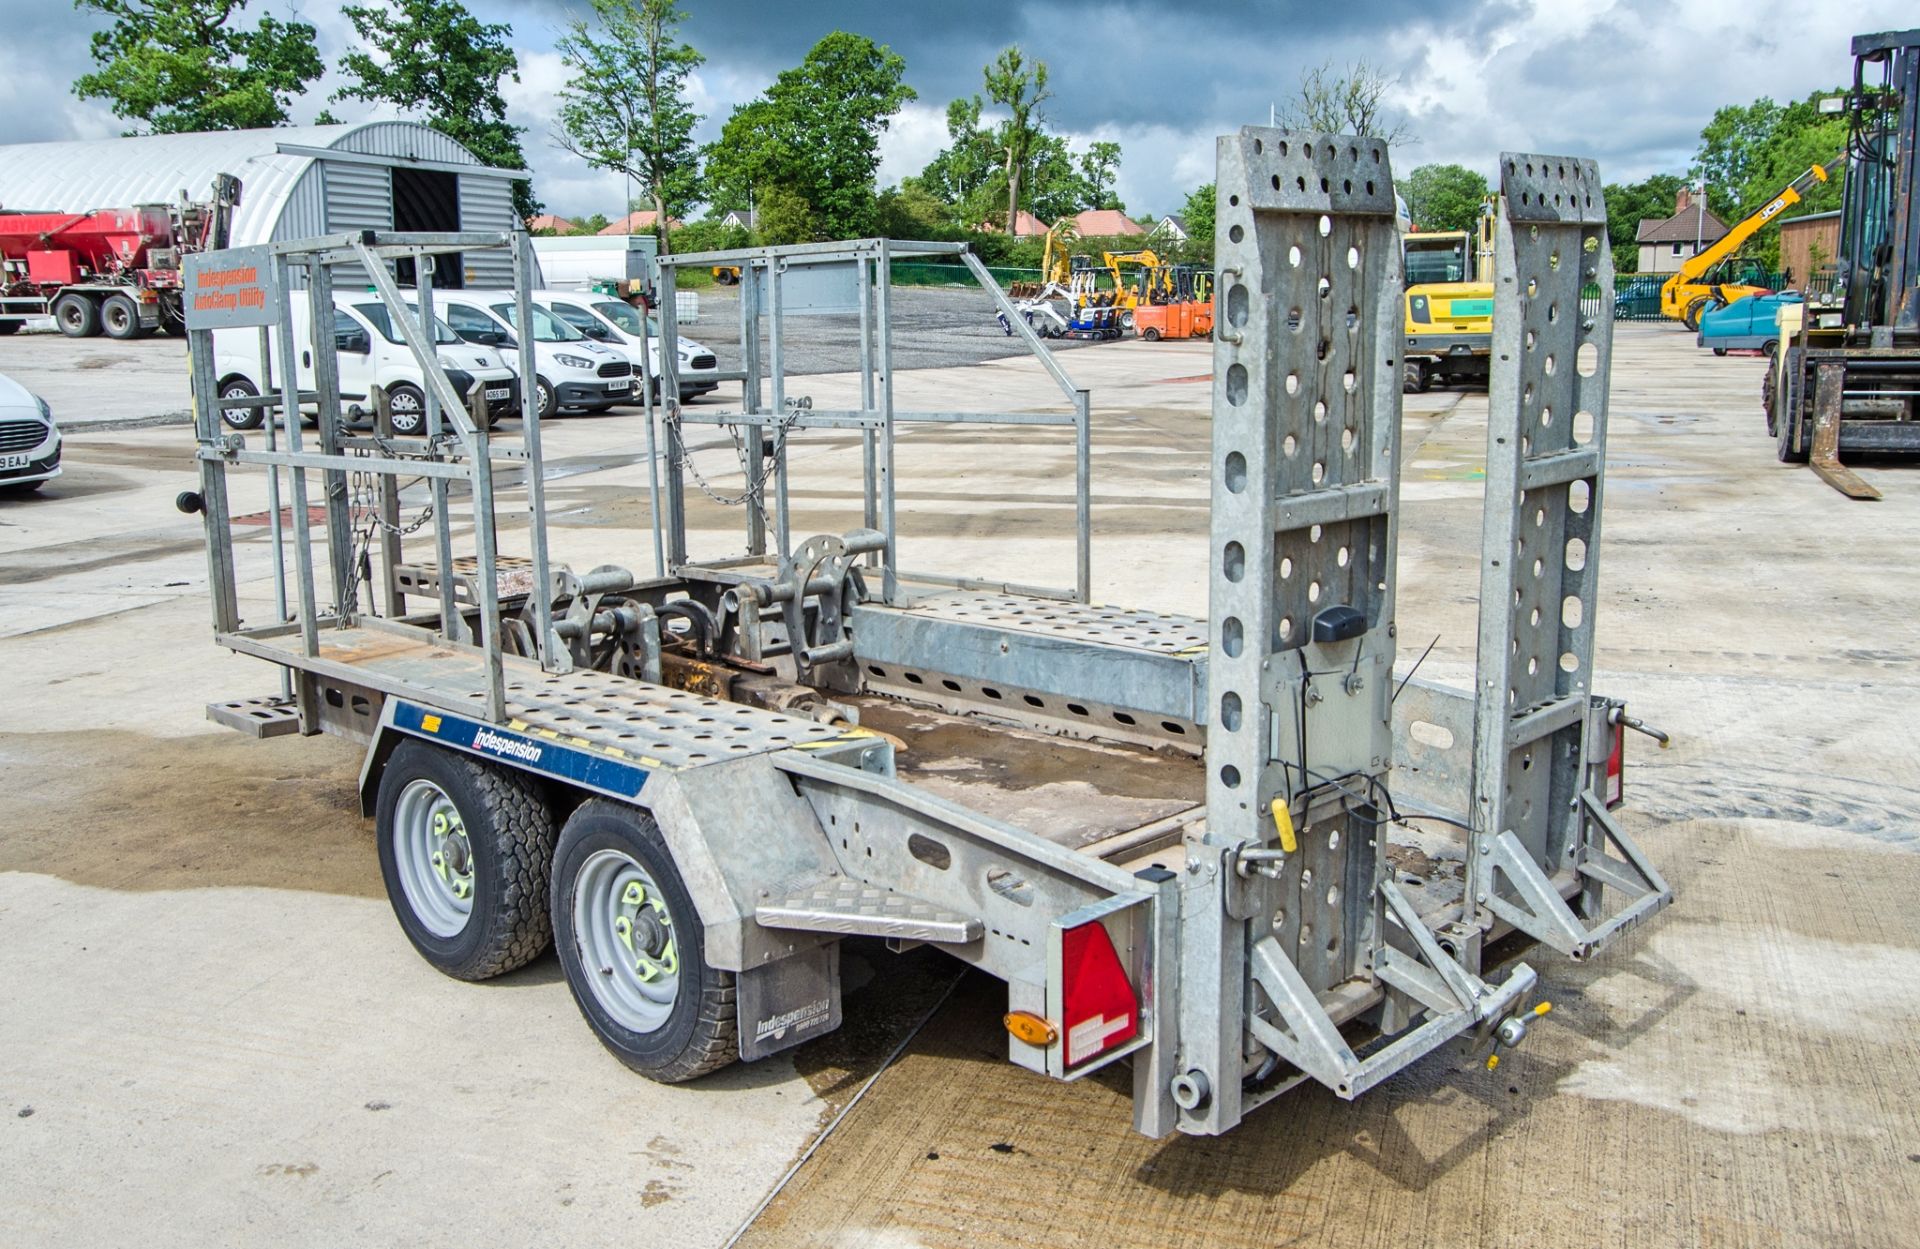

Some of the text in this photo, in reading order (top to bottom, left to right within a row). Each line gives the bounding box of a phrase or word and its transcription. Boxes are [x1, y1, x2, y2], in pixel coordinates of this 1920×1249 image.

[1761, 199, 1785, 220] JCB
[0, 218, 52, 232] ASYMIX
[194, 287, 265, 311] AutoClamp Utility
[8, 455, 28, 468] EAJ
[474, 727, 542, 762] indespension
[756, 998, 830, 1035] Indespension
